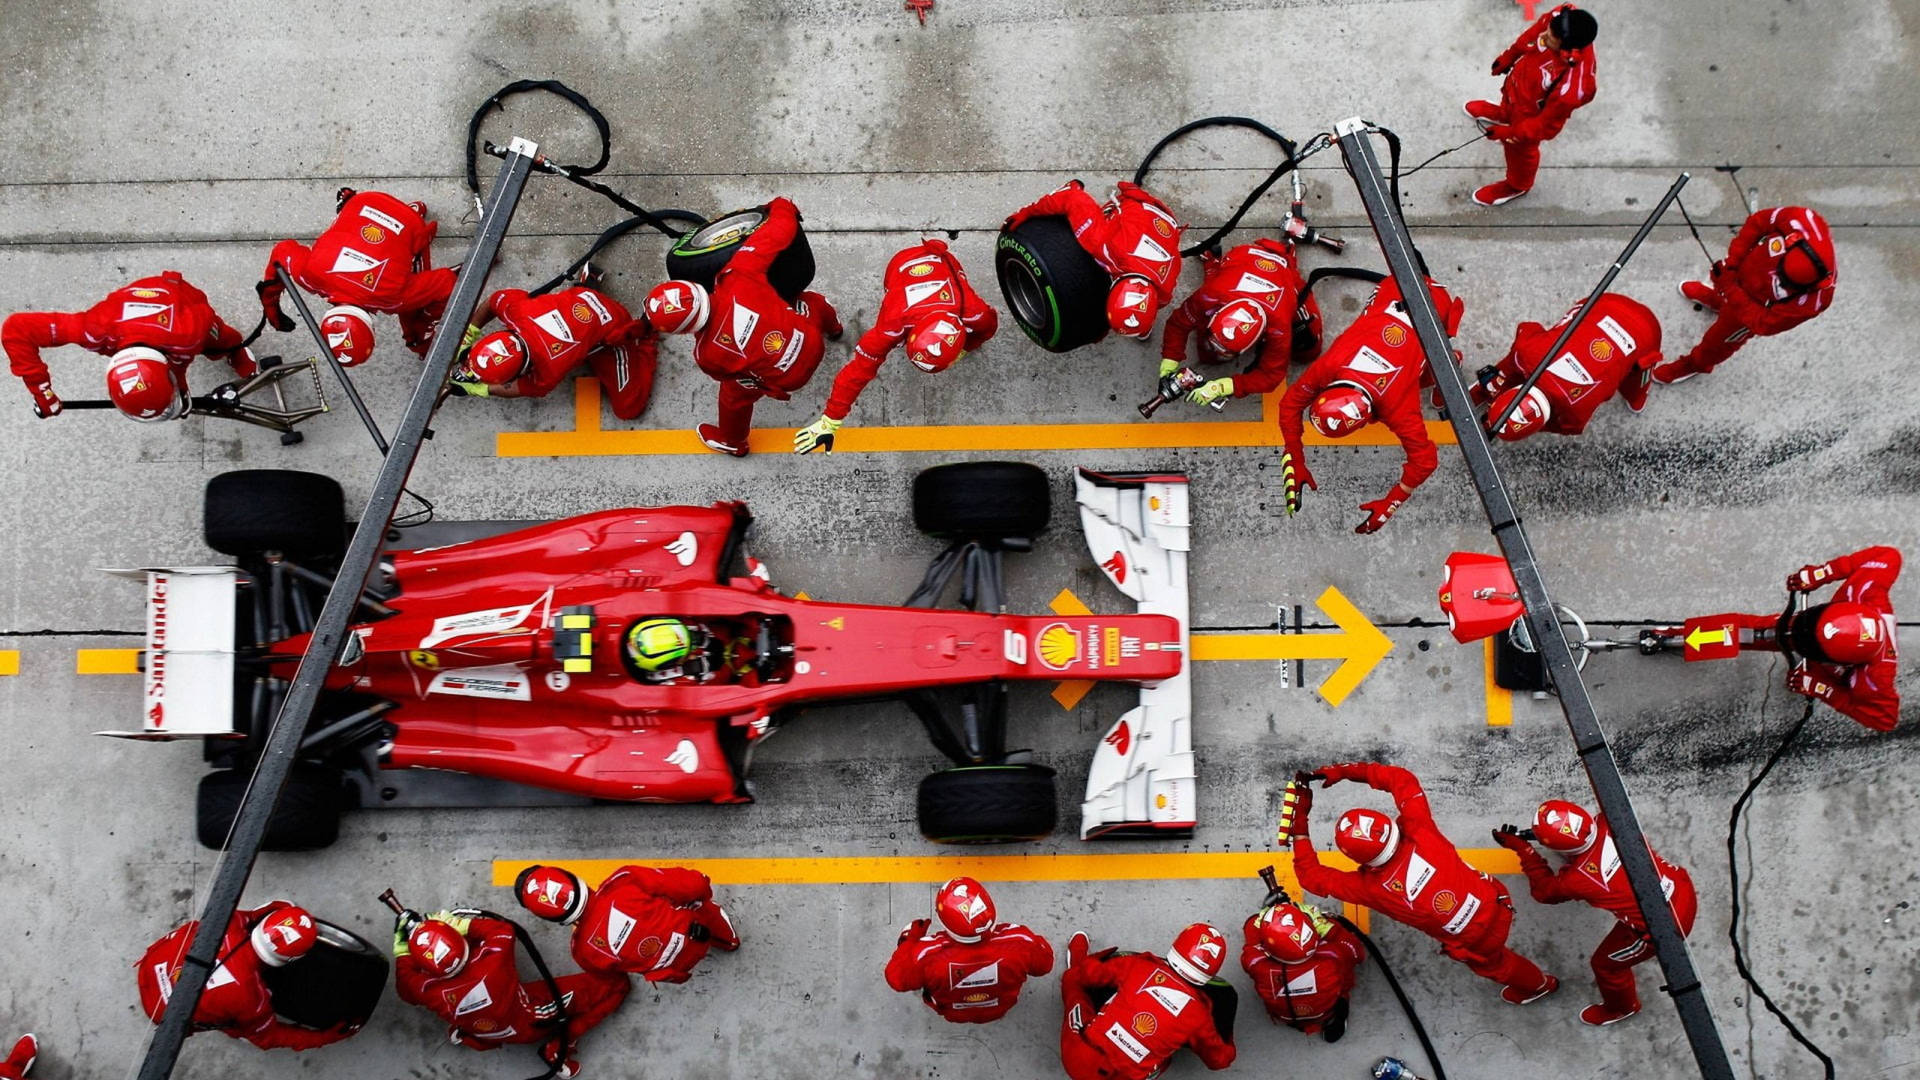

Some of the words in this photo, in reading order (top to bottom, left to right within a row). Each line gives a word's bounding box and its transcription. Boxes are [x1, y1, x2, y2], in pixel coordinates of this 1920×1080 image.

[1000, 236, 1042, 277] Cinturato
[149, 573, 167, 697] Santander
[1004, 629, 1027, 665] 6
[1120, 635, 1141, 658] FIAT
[1117, 1033, 1144, 1059] Santander
